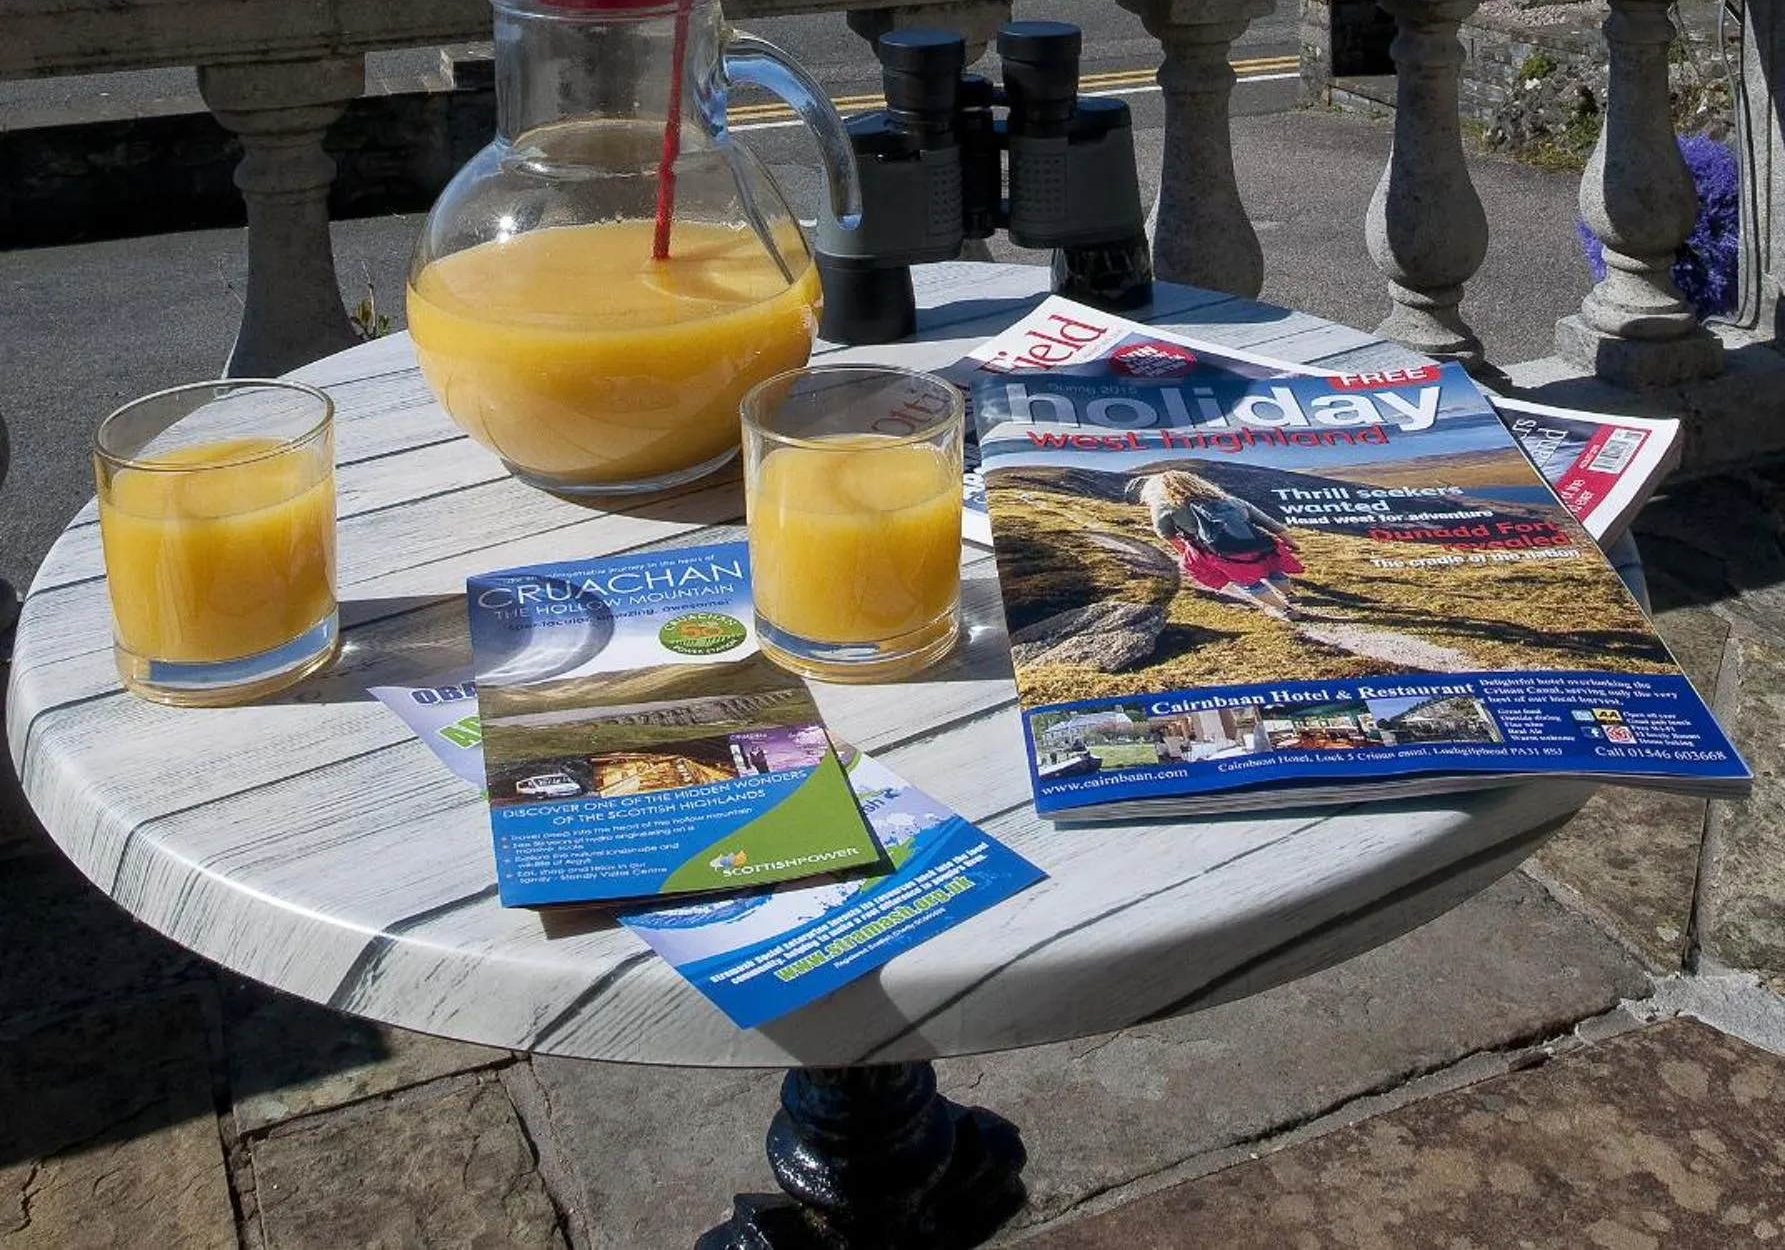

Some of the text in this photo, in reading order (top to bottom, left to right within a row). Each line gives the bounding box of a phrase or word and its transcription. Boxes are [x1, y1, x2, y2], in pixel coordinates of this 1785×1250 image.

[1338, 367, 1427, 387] FREE
[1006, 383, 1441, 431] holiday
[1026, 424, 1391, 454] west highland
[1271, 486, 1465, 501] Thrill seekers
[1279, 500, 1391, 514] wanted
[1284, 510, 1495, 525] Head west for adventure
[1367, 520, 1560, 541] Dunadd Fort
[1440, 531, 1573, 552] revealed
[1370, 549, 1582, 569] The cradle of the nation
[478, 559, 743, 610] CRUACHAN
[494, 584, 734, 621] THE HOLLOW MOUNTAIN
[1479, 677, 1652, 690] Delightful hotel overlooking the
[1483, 686, 1525, 695] Crinan
[1526, 685, 1565, 695] Canal,
[1633, 690, 1652, 699] the
[1653, 691, 1679, 700] very
[1151, 682, 1476, 715] Cairnbaan Hotel & Restaurant
[1217, 757, 1275, 773] Cairnbaan
[1509, 747, 1540, 756] PA31
[1594, 745, 1728, 762] Call 01546 603668
[1040, 767, 1189, 796] www.cairnbaan.com
[502, 770, 808, 819] DISCOVER ONE OF THE HIDDEN WONDERS
[552, 789, 767, 826] OF THE SCOTTISH HIGHLANDS
[705, 807, 754, 821] mountain
[723, 846, 861, 878] SCOTTISHPOWER
[773, 874, 977, 982] www.stramash.org.uk
